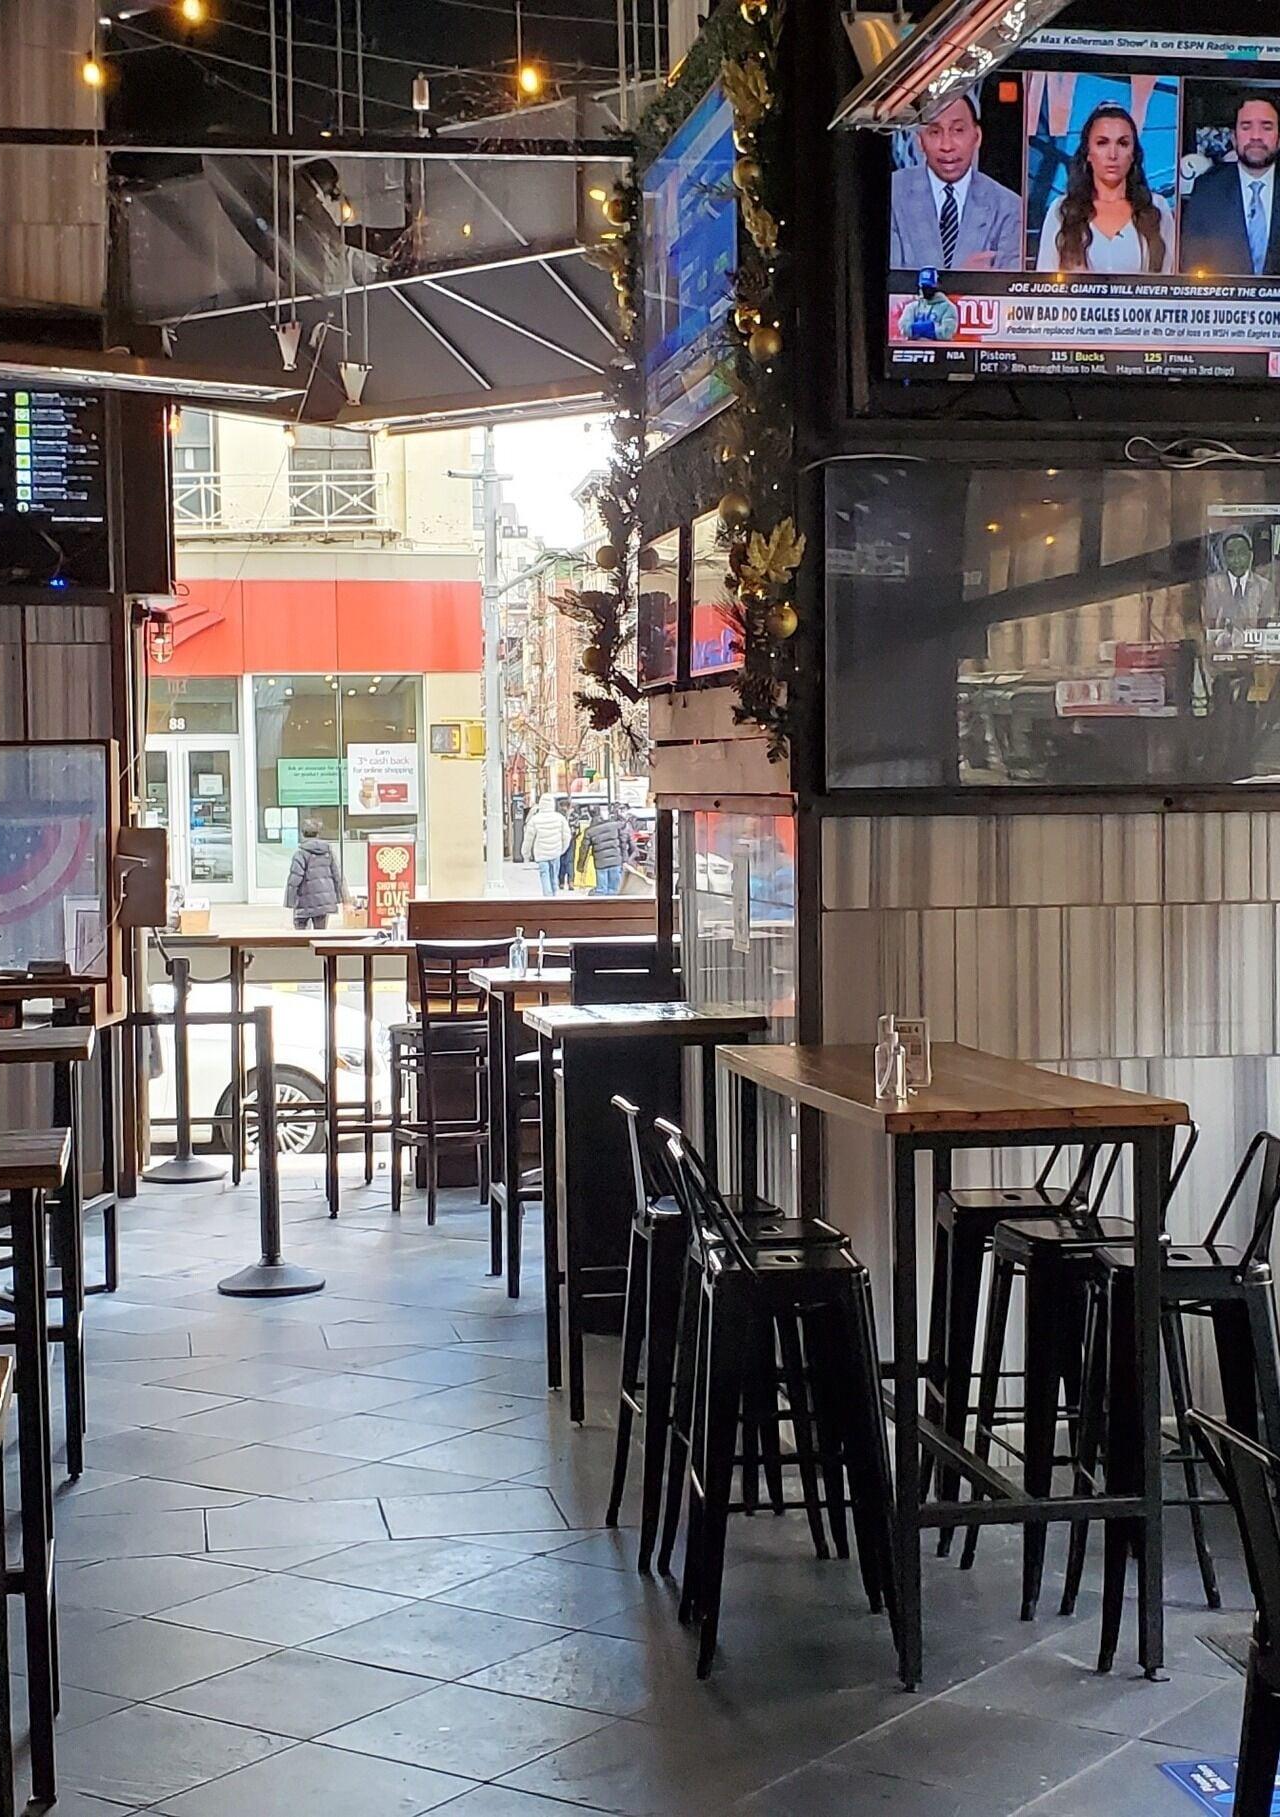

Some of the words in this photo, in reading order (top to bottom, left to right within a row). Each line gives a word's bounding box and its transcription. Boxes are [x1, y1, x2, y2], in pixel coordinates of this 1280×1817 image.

[1063, 36, 1113, 46] Kellerman
[1150, 40, 1158, 48] is
[1177, 41, 1204, 50] ESPN
[1207, 42, 1234, 51] Radio
[1008, 283, 1029, 293] JOE
[1030, 283, 1068, 293] JUDGE:
[1070, 284, 1108, 294] GIANTS
[1110, 285, 1133, 295] WILL
[1135, 285, 1168, 295] NEVER
[1237, 287, 1257, 297] THE
[1007, 306, 1035, 321] HOW
[1037, 306, 1059, 321] BAD
[1062, 307, 1077, 322] DO
[1080, 307, 1120, 323] EAGLES
[1122, 308, 1152, 323] LOOK
[1154, 308, 1188, 324] AFTER
[1190, 309, 1210, 325] JOE
[1212, 310, 1256, 326] JUDGE'S
[1043, 326, 1076, 336] replaced
[1098, 327, 1113, 336] with
[1143, 328, 1150, 336] in
[1178, 328, 1185, 337] of
[1203, 330, 1211, 338] vs
[1231, 329, 1246, 338] with
[1247, 329, 1271, 340] Eagles
[892, 350, 936, 363] ESPN
[946, 351, 965, 360] NBA
[980, 350, 1017, 361] Pistons
[1051, 352, 1068, 361] 115
[1075, 352, 1105, 362] Bucks
[1144, 353, 1162, 363] 125
[1170, 355, 1194, 363] FINAL
[980, 363, 998, 373] DET
[1028, 364, 1061, 375] straight
[1080, 365, 1090, 373] to
[1146, 366, 1163, 376] Left
[1189, 367, 1197, 375] in
[1198, 367, 1213, 376] 3rd
[169, 717, 185, 731] 88
[369, 757, 388, 765] cash
[390, 756, 409, 765] back
[364, 766, 383, 774] online
[384, 766, 413, 776] shopping
[376, 890, 410, 907] LOVE
